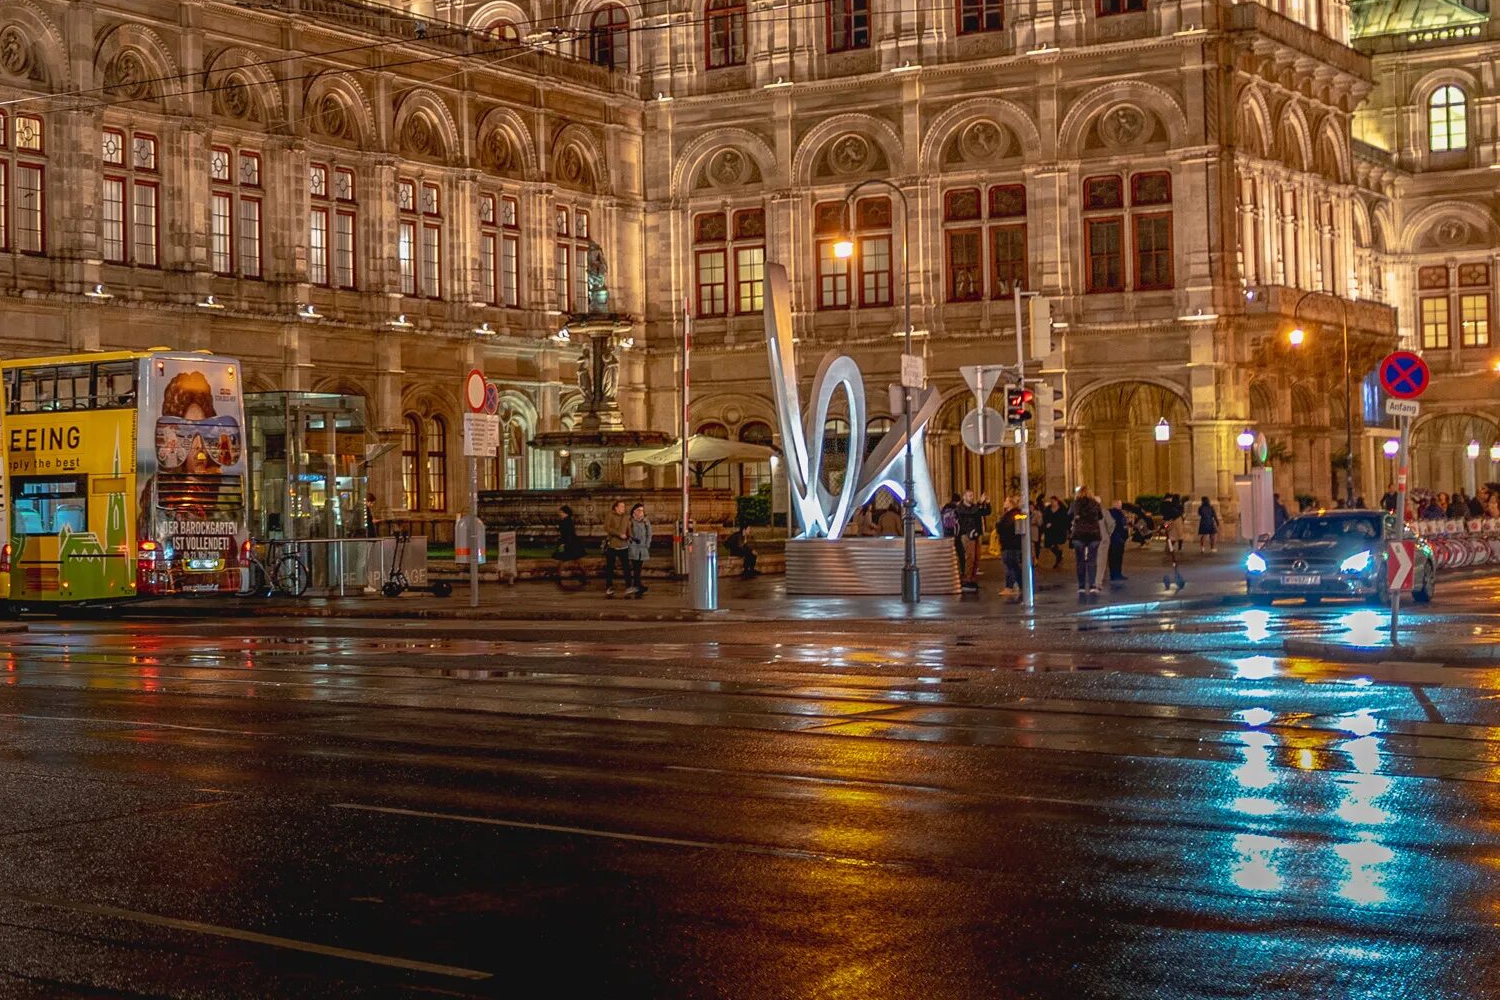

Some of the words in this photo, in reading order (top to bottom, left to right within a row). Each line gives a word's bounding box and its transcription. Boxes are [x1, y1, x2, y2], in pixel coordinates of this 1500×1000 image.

[1389, 402, 1417, 414] Anfang
[34, 457, 51, 468] the
[56, 457, 80, 468] best
[163, 521, 178, 534] DER
[181, 521, 238, 535] BAROCKGARTEN
[173, 537, 184, 550] IST
[185, 536, 229, 550] VOLLENDET!
